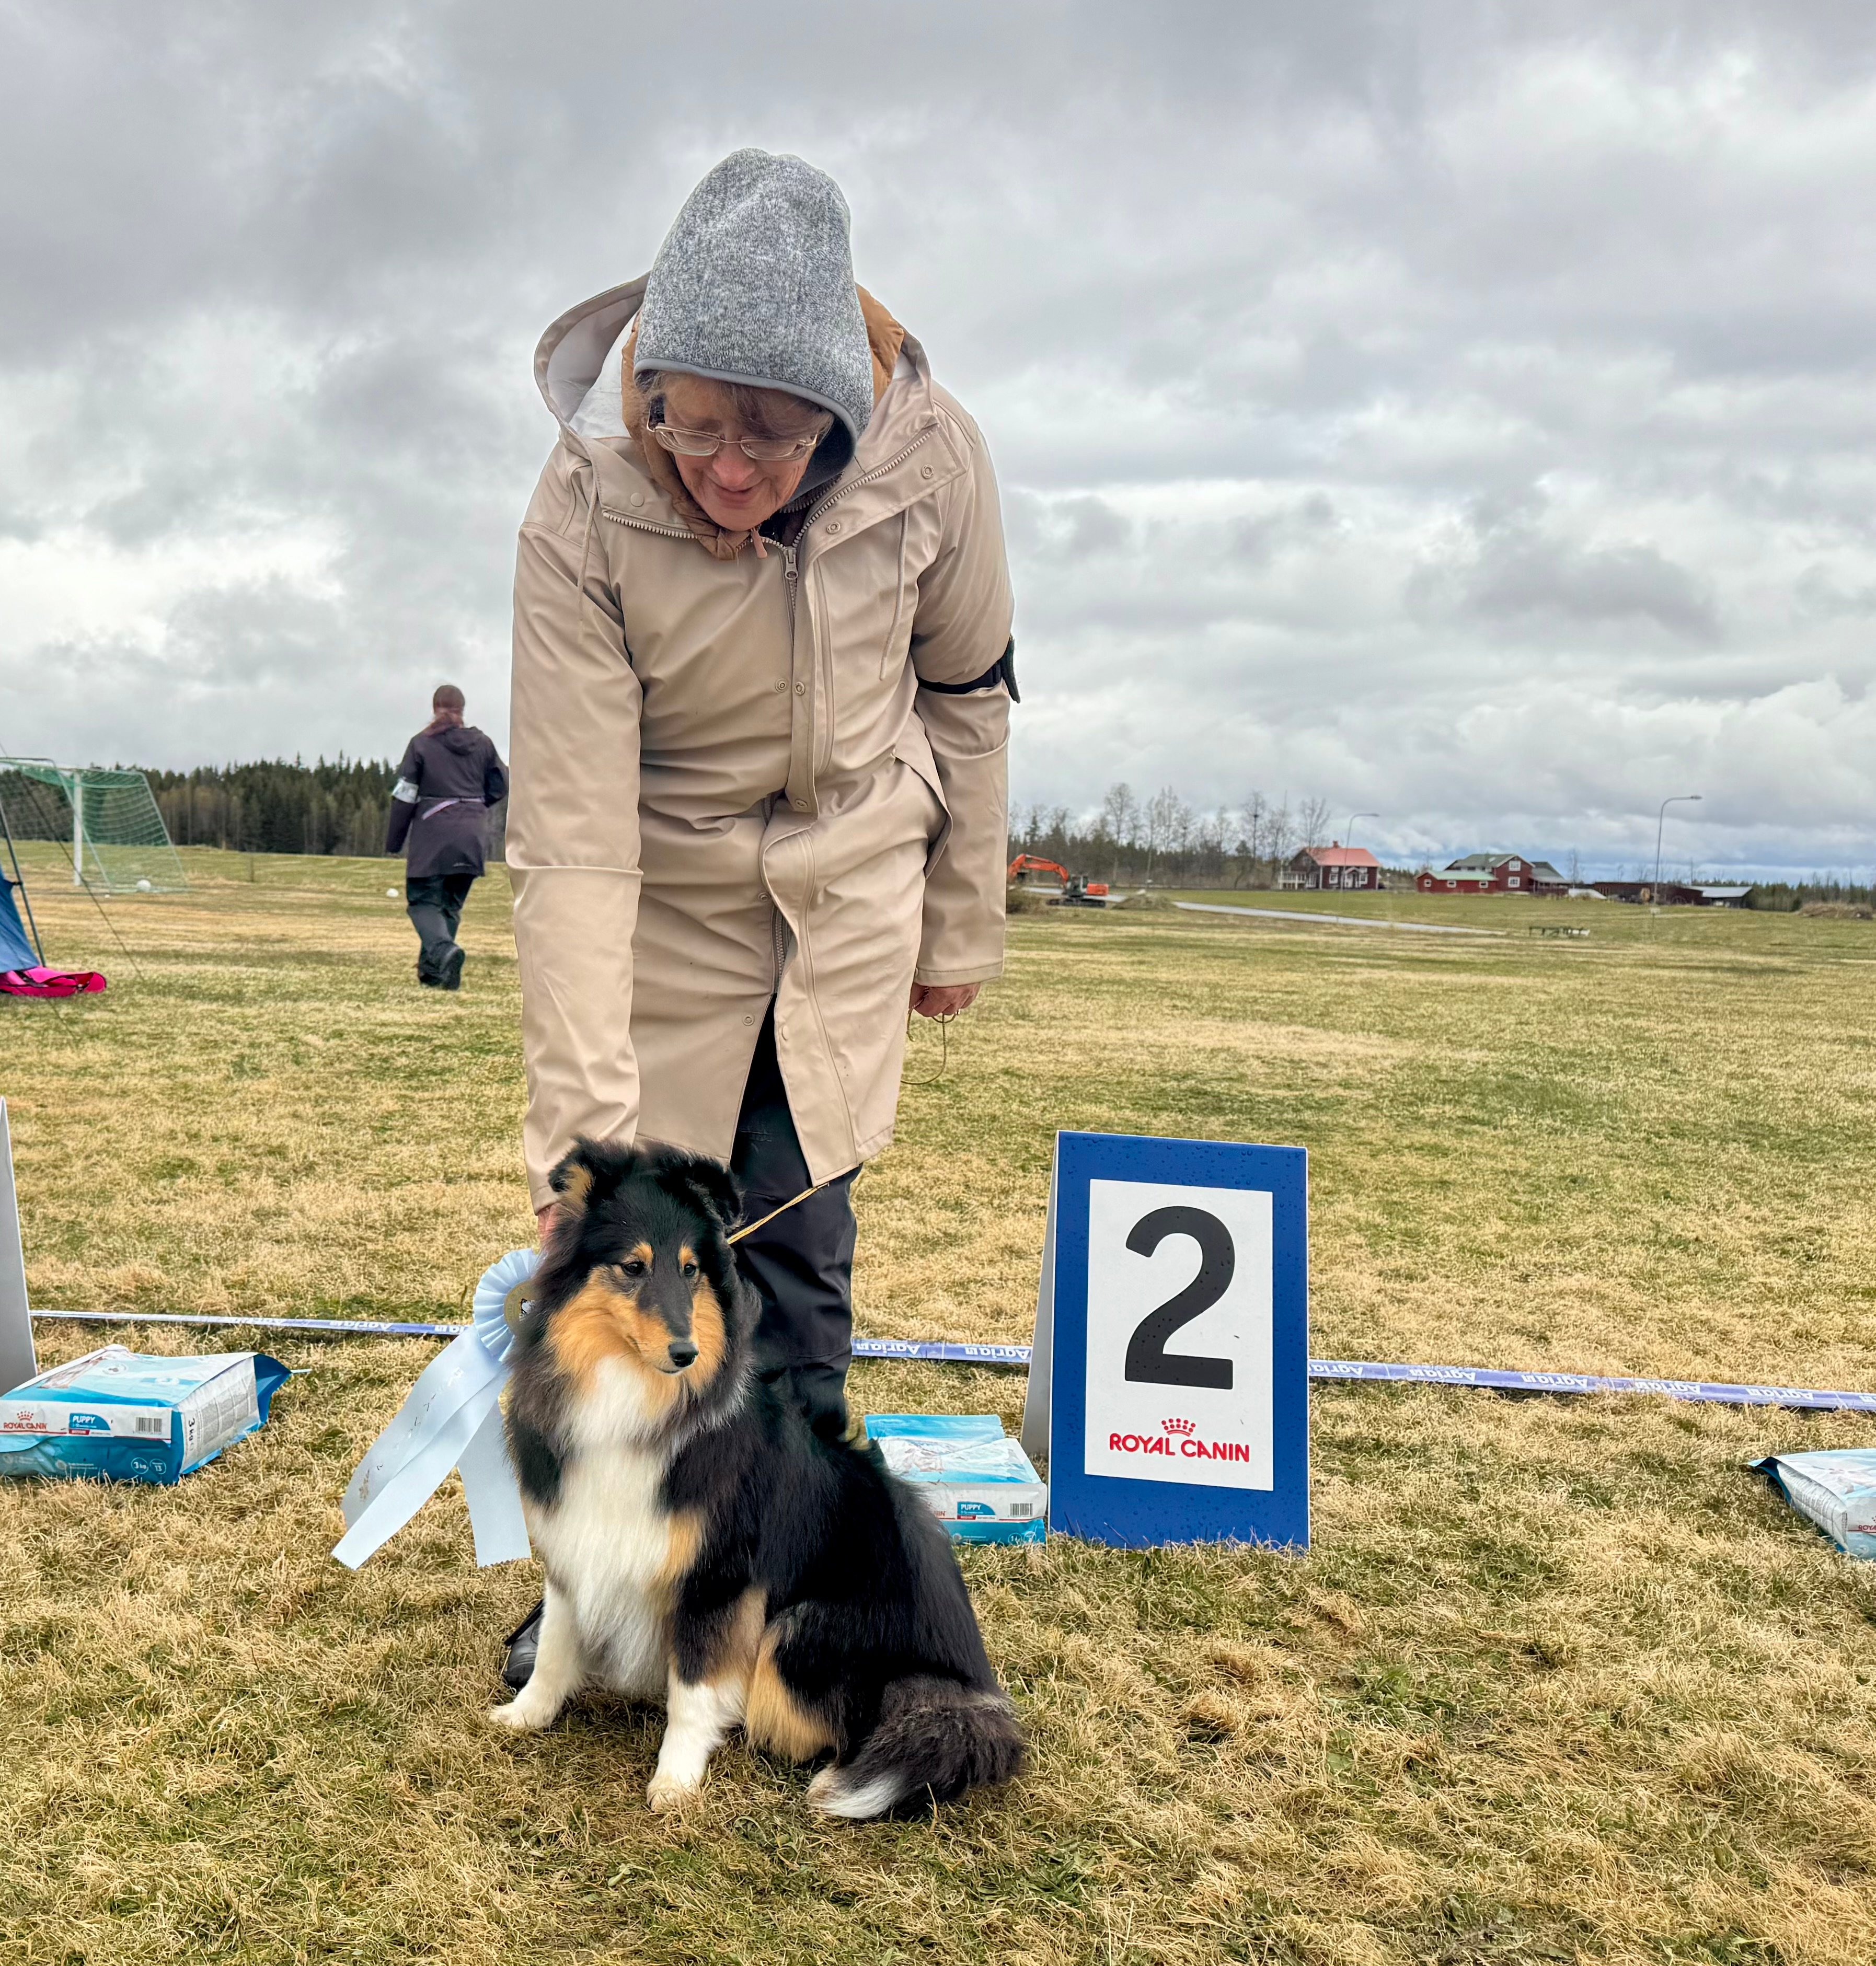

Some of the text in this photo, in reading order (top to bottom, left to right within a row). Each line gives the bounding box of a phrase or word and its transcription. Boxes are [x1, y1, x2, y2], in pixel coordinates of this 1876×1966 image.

[1124, 1205, 1236, 1390] 2
[72, 1415, 96, 1424] PUPPY
[189, 1418, 195, 1427] 3
[1109, 1432, 1250, 1463] ROYAL CANIN
